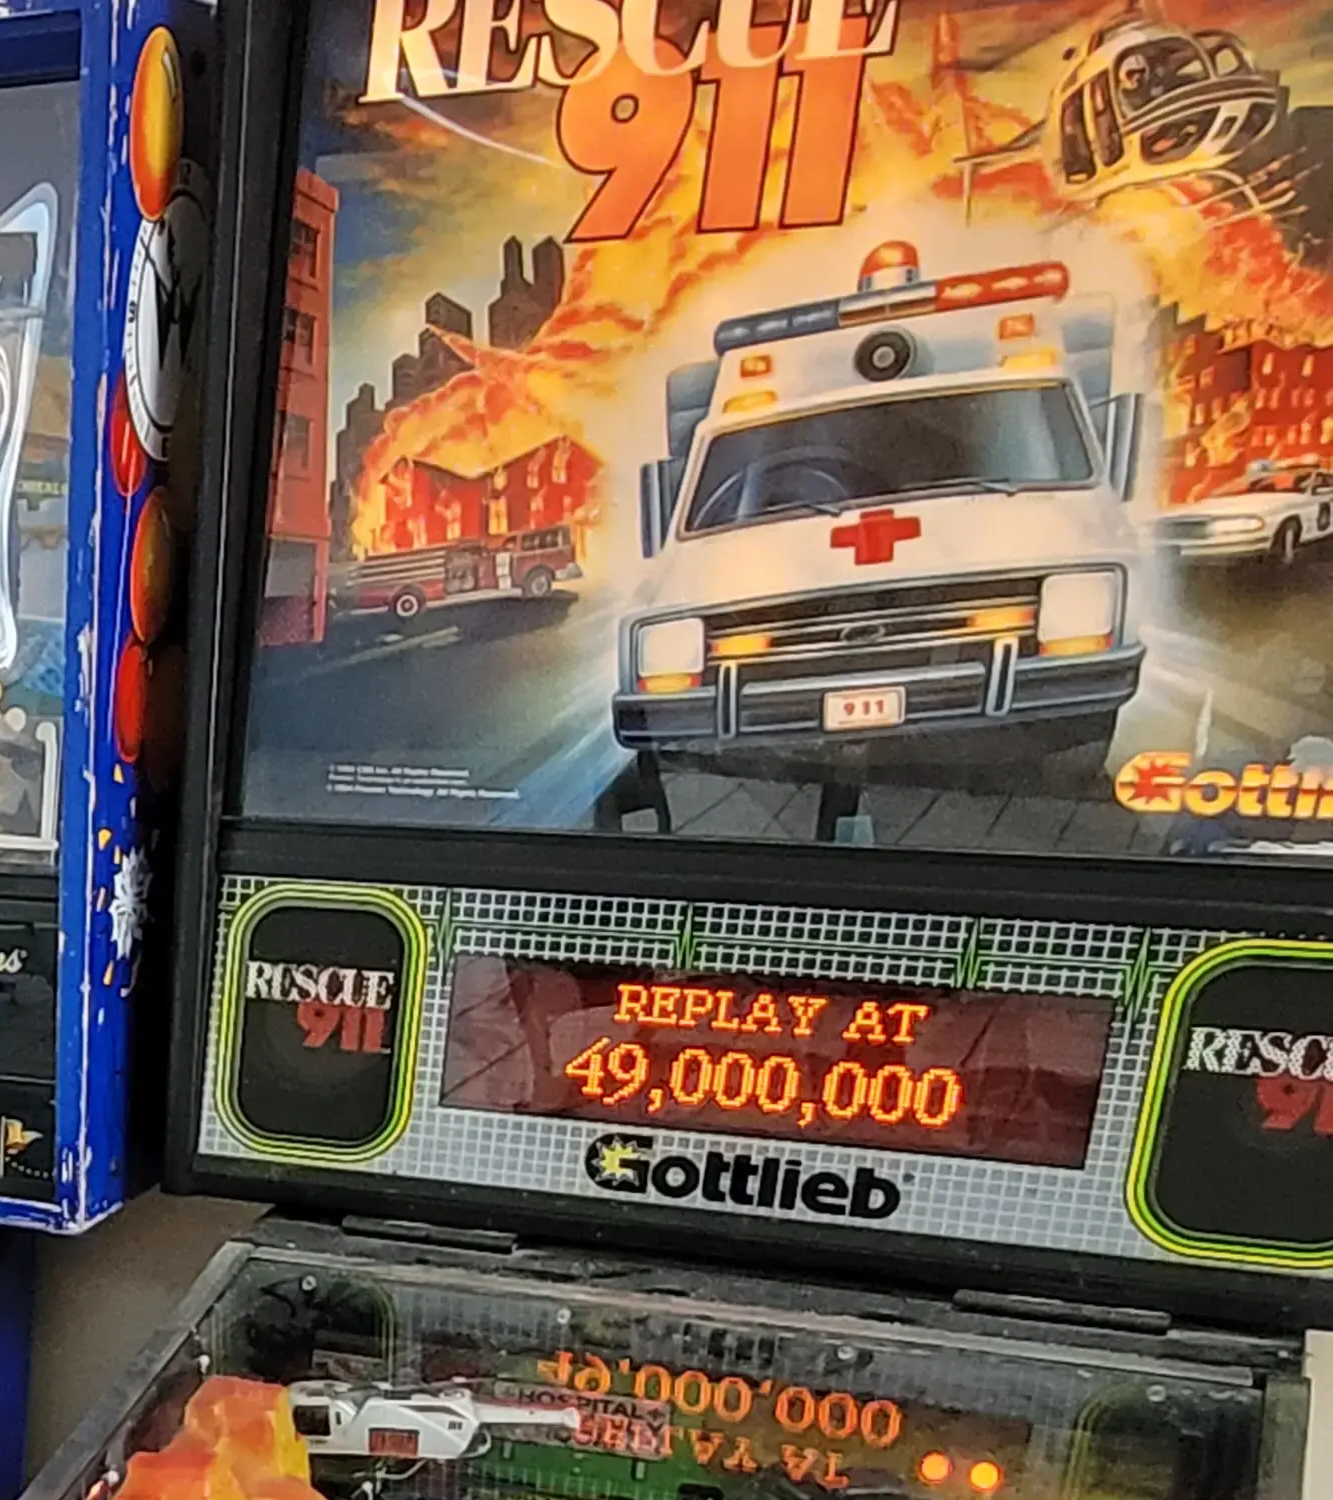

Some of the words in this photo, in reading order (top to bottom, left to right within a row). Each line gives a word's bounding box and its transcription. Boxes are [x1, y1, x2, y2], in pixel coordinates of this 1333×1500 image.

[556, 17, 867, 244] 911
[844, 699, 885, 717] 911
[245, 960, 395, 1011] RESCUE
[614, 983, 828, 1038] REPLAY
[842, 1000, 930, 1045] AT
[296, 1001, 386, 1054] 911
[1182, 1027, 1333, 1083] RESC
[565, 1035, 963, 1129] 49,000,000
[1255, 1073, 1333, 1133] 91
[585, 1132, 902, 1220] Gottlieb
